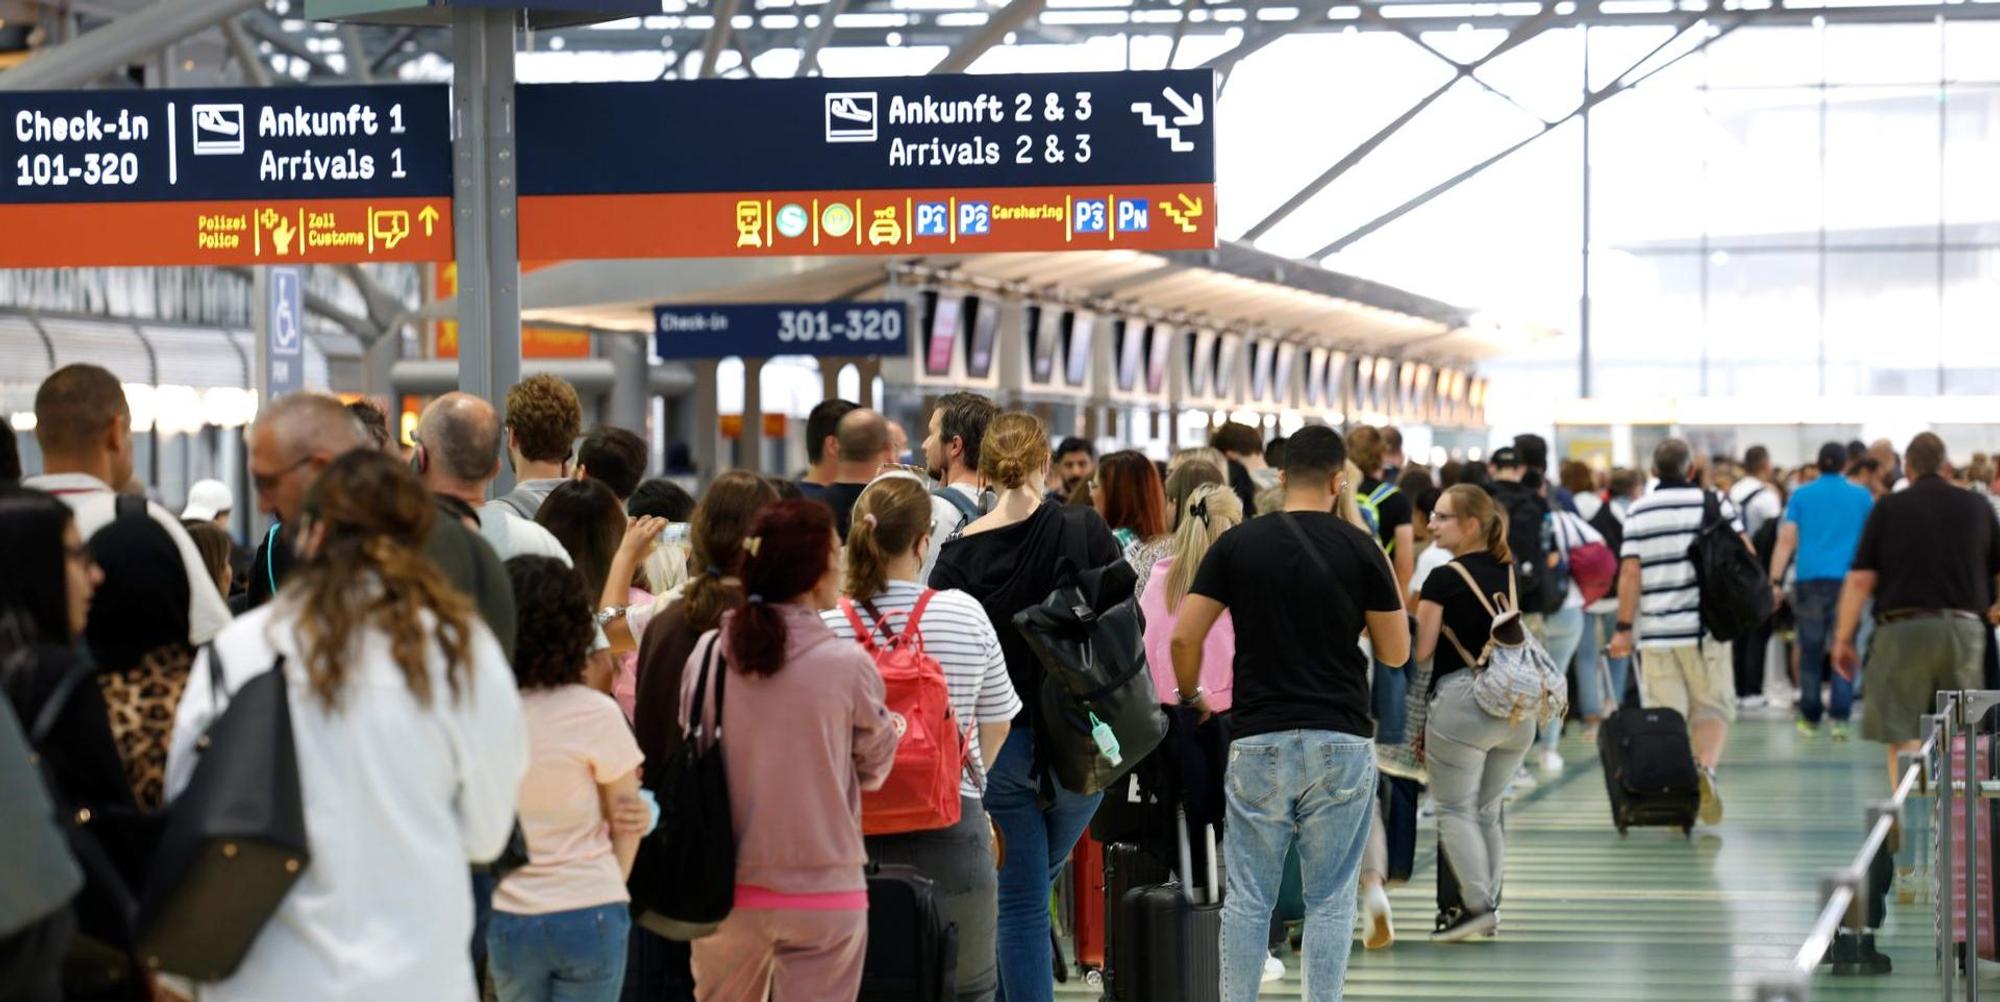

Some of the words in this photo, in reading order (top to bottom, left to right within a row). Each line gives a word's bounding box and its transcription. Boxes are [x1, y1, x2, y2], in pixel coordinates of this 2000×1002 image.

[259, 104, 379, 137] Ankunft
[389, 103, 406, 134] 1
[888, 94, 1004, 125] Ankunft
[1014, 92, 1033, 122] 2
[1043, 92, 1065, 121] &
[1074, 91, 1092, 121] 3
[15, 108, 149, 142] Check-in
[260, 149, 375, 181] Arrivals
[390, 147, 407, 179] 1
[889, 135, 1001, 167] Arrivals
[1015, 134, 1034, 164] 2
[1044, 134, 1065, 163] &
[1074, 133, 1092, 162] 3
[16, 153, 139, 186] 101-320
[198, 214, 248, 231] Polizei
[308, 212, 336, 229] Zoll
[991, 204, 1064, 222] Carsharing
[198, 231, 240, 249] Police
[308, 230, 365, 247] Customs
[660, 313, 729, 332] Check-in
[778, 309, 901, 342] 301-320
